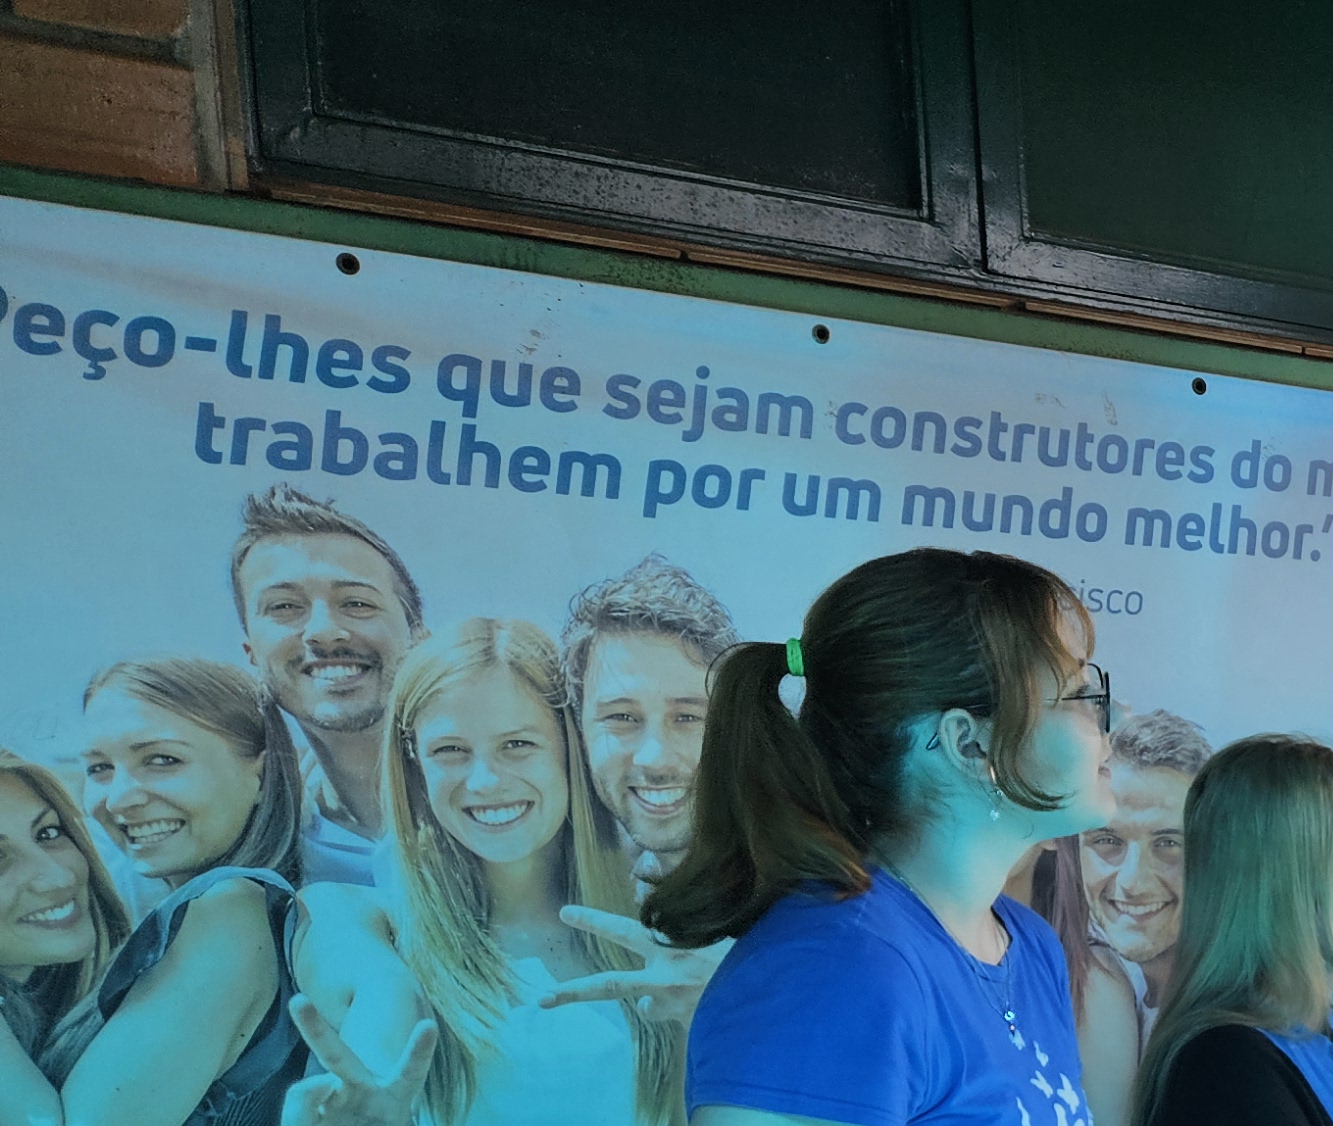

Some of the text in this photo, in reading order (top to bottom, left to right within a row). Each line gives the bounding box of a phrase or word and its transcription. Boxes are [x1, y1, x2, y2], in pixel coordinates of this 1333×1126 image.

[0, 284, 412, 394] eço-lhes
[437, 353, 581, 418] que
[602, 365, 813, 442] sejam
[834, 401, 1216, 484] construtores
[1230, 439, 1292, 492] do
[195, 401, 622, 500] trabalhem
[643, 459, 766, 518] por
[782, 472, 882, 522] um
[901, 486, 1108, 542] mundo
